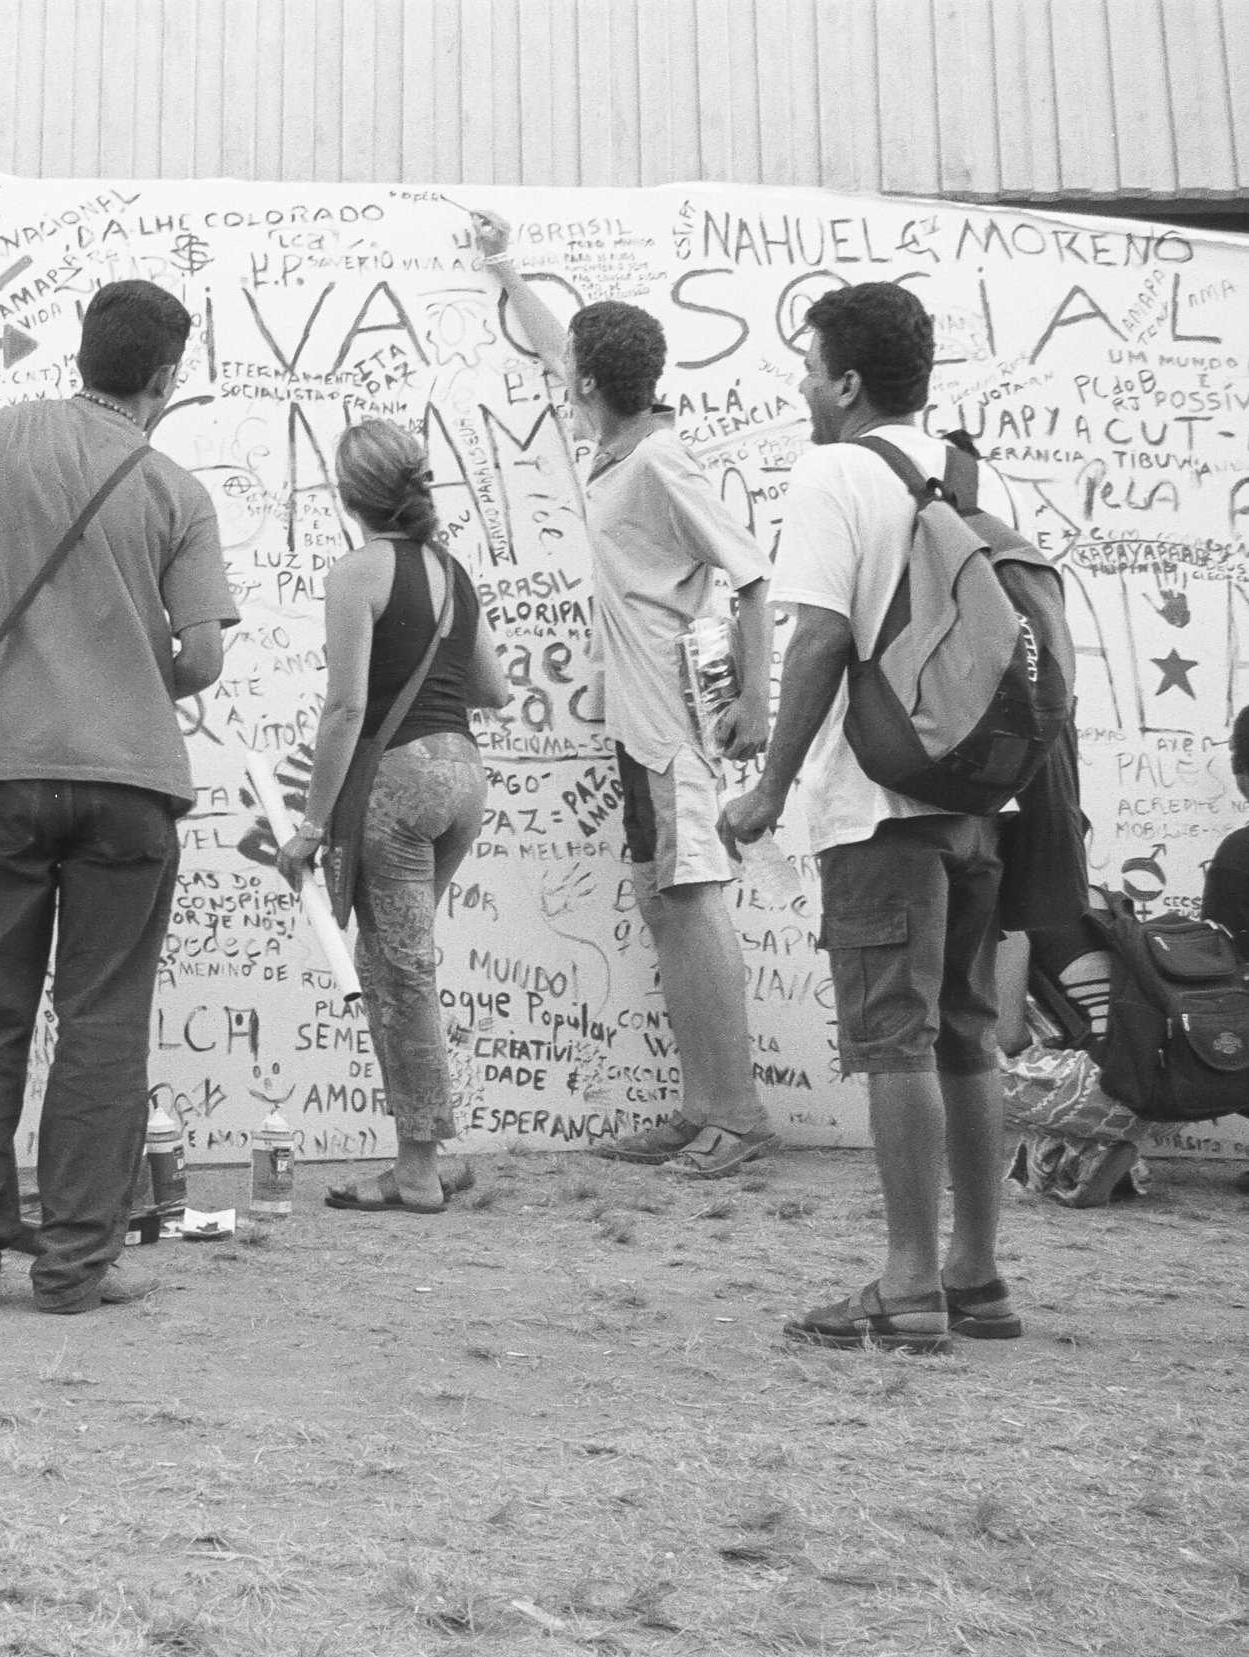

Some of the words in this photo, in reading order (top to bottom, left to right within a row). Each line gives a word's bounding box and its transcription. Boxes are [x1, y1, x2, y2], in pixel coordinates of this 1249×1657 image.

[204, 204, 384, 228] COLORADO
[703, 209, 892, 266] NAHUEL
[254, 549, 303, 569] LUZ
[478, 568, 583, 607] BRASIL
[180, 961, 252, 978] MENINO
[264, 963, 289, 982] DE
[350, 1061, 375, 1078] DE
[485, 1064, 547, 1091] DADE
